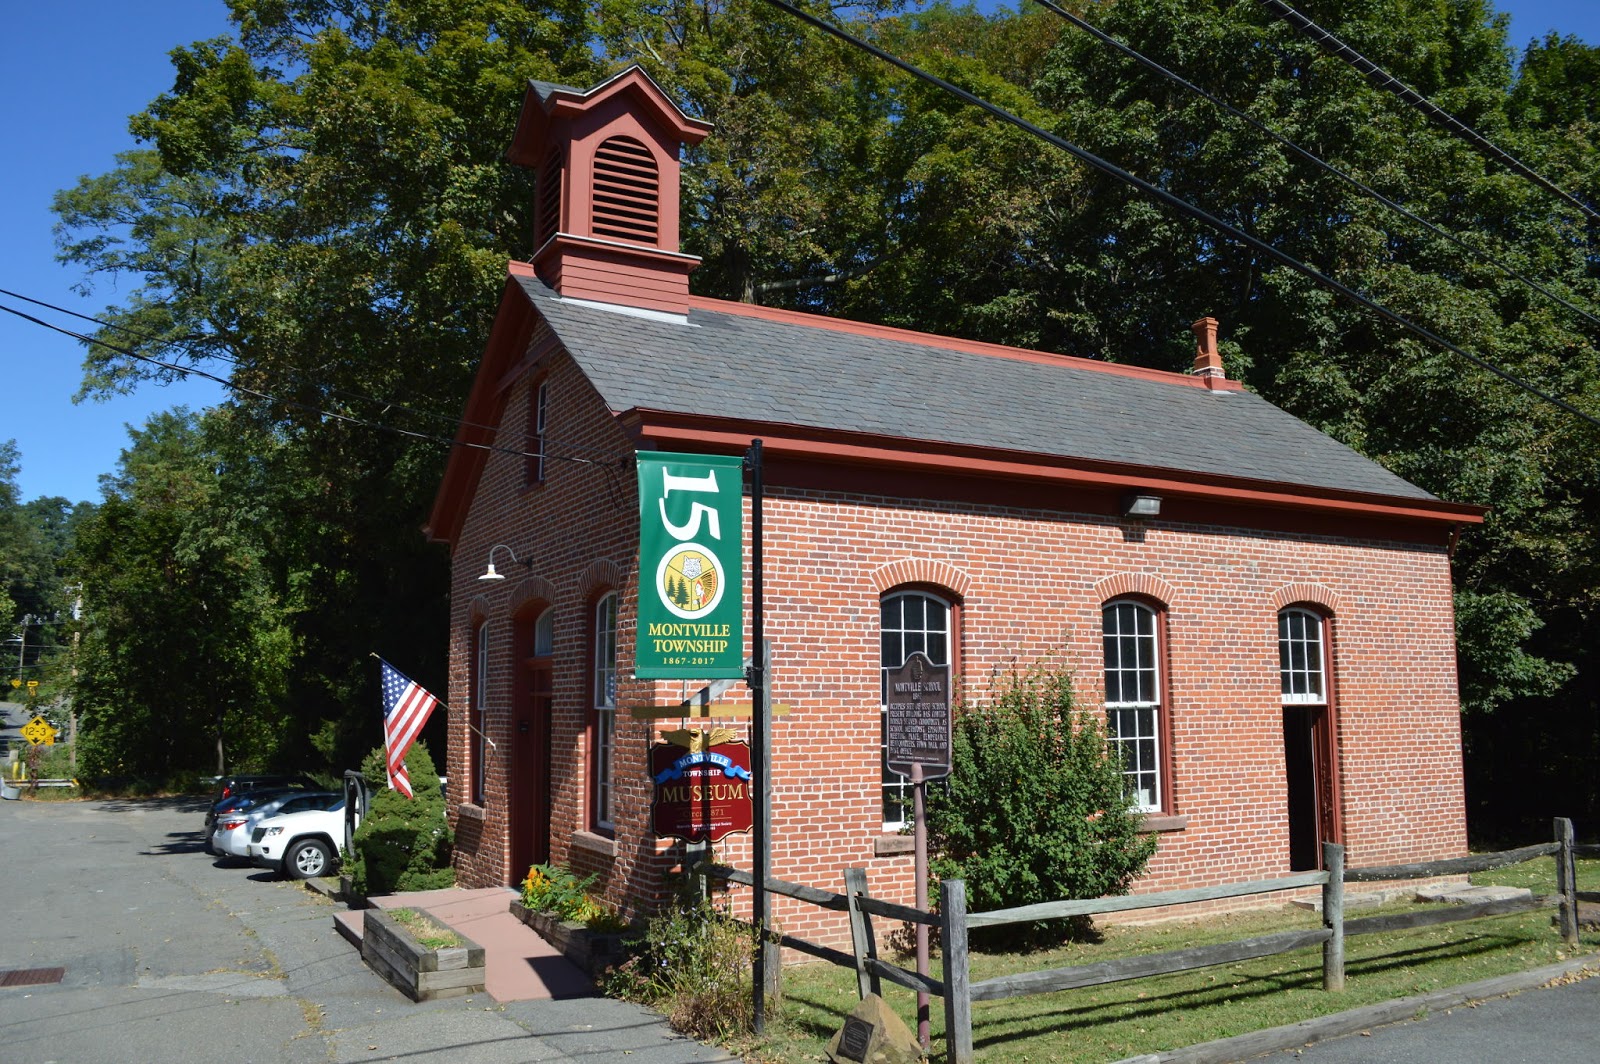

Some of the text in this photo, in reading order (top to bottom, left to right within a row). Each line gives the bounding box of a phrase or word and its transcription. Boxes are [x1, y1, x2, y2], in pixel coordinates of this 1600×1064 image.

[648, 623, 730, 637] MONTVILLE
[653, 639, 728, 653] TOWNSHIP
[663, 657, 715, 665] 1867-2017
[679, 754, 729, 768] MONTVILLE
[682, 769, 722, 778] TOWNSHIP
[663, 783, 744, 803] MUSEUM
